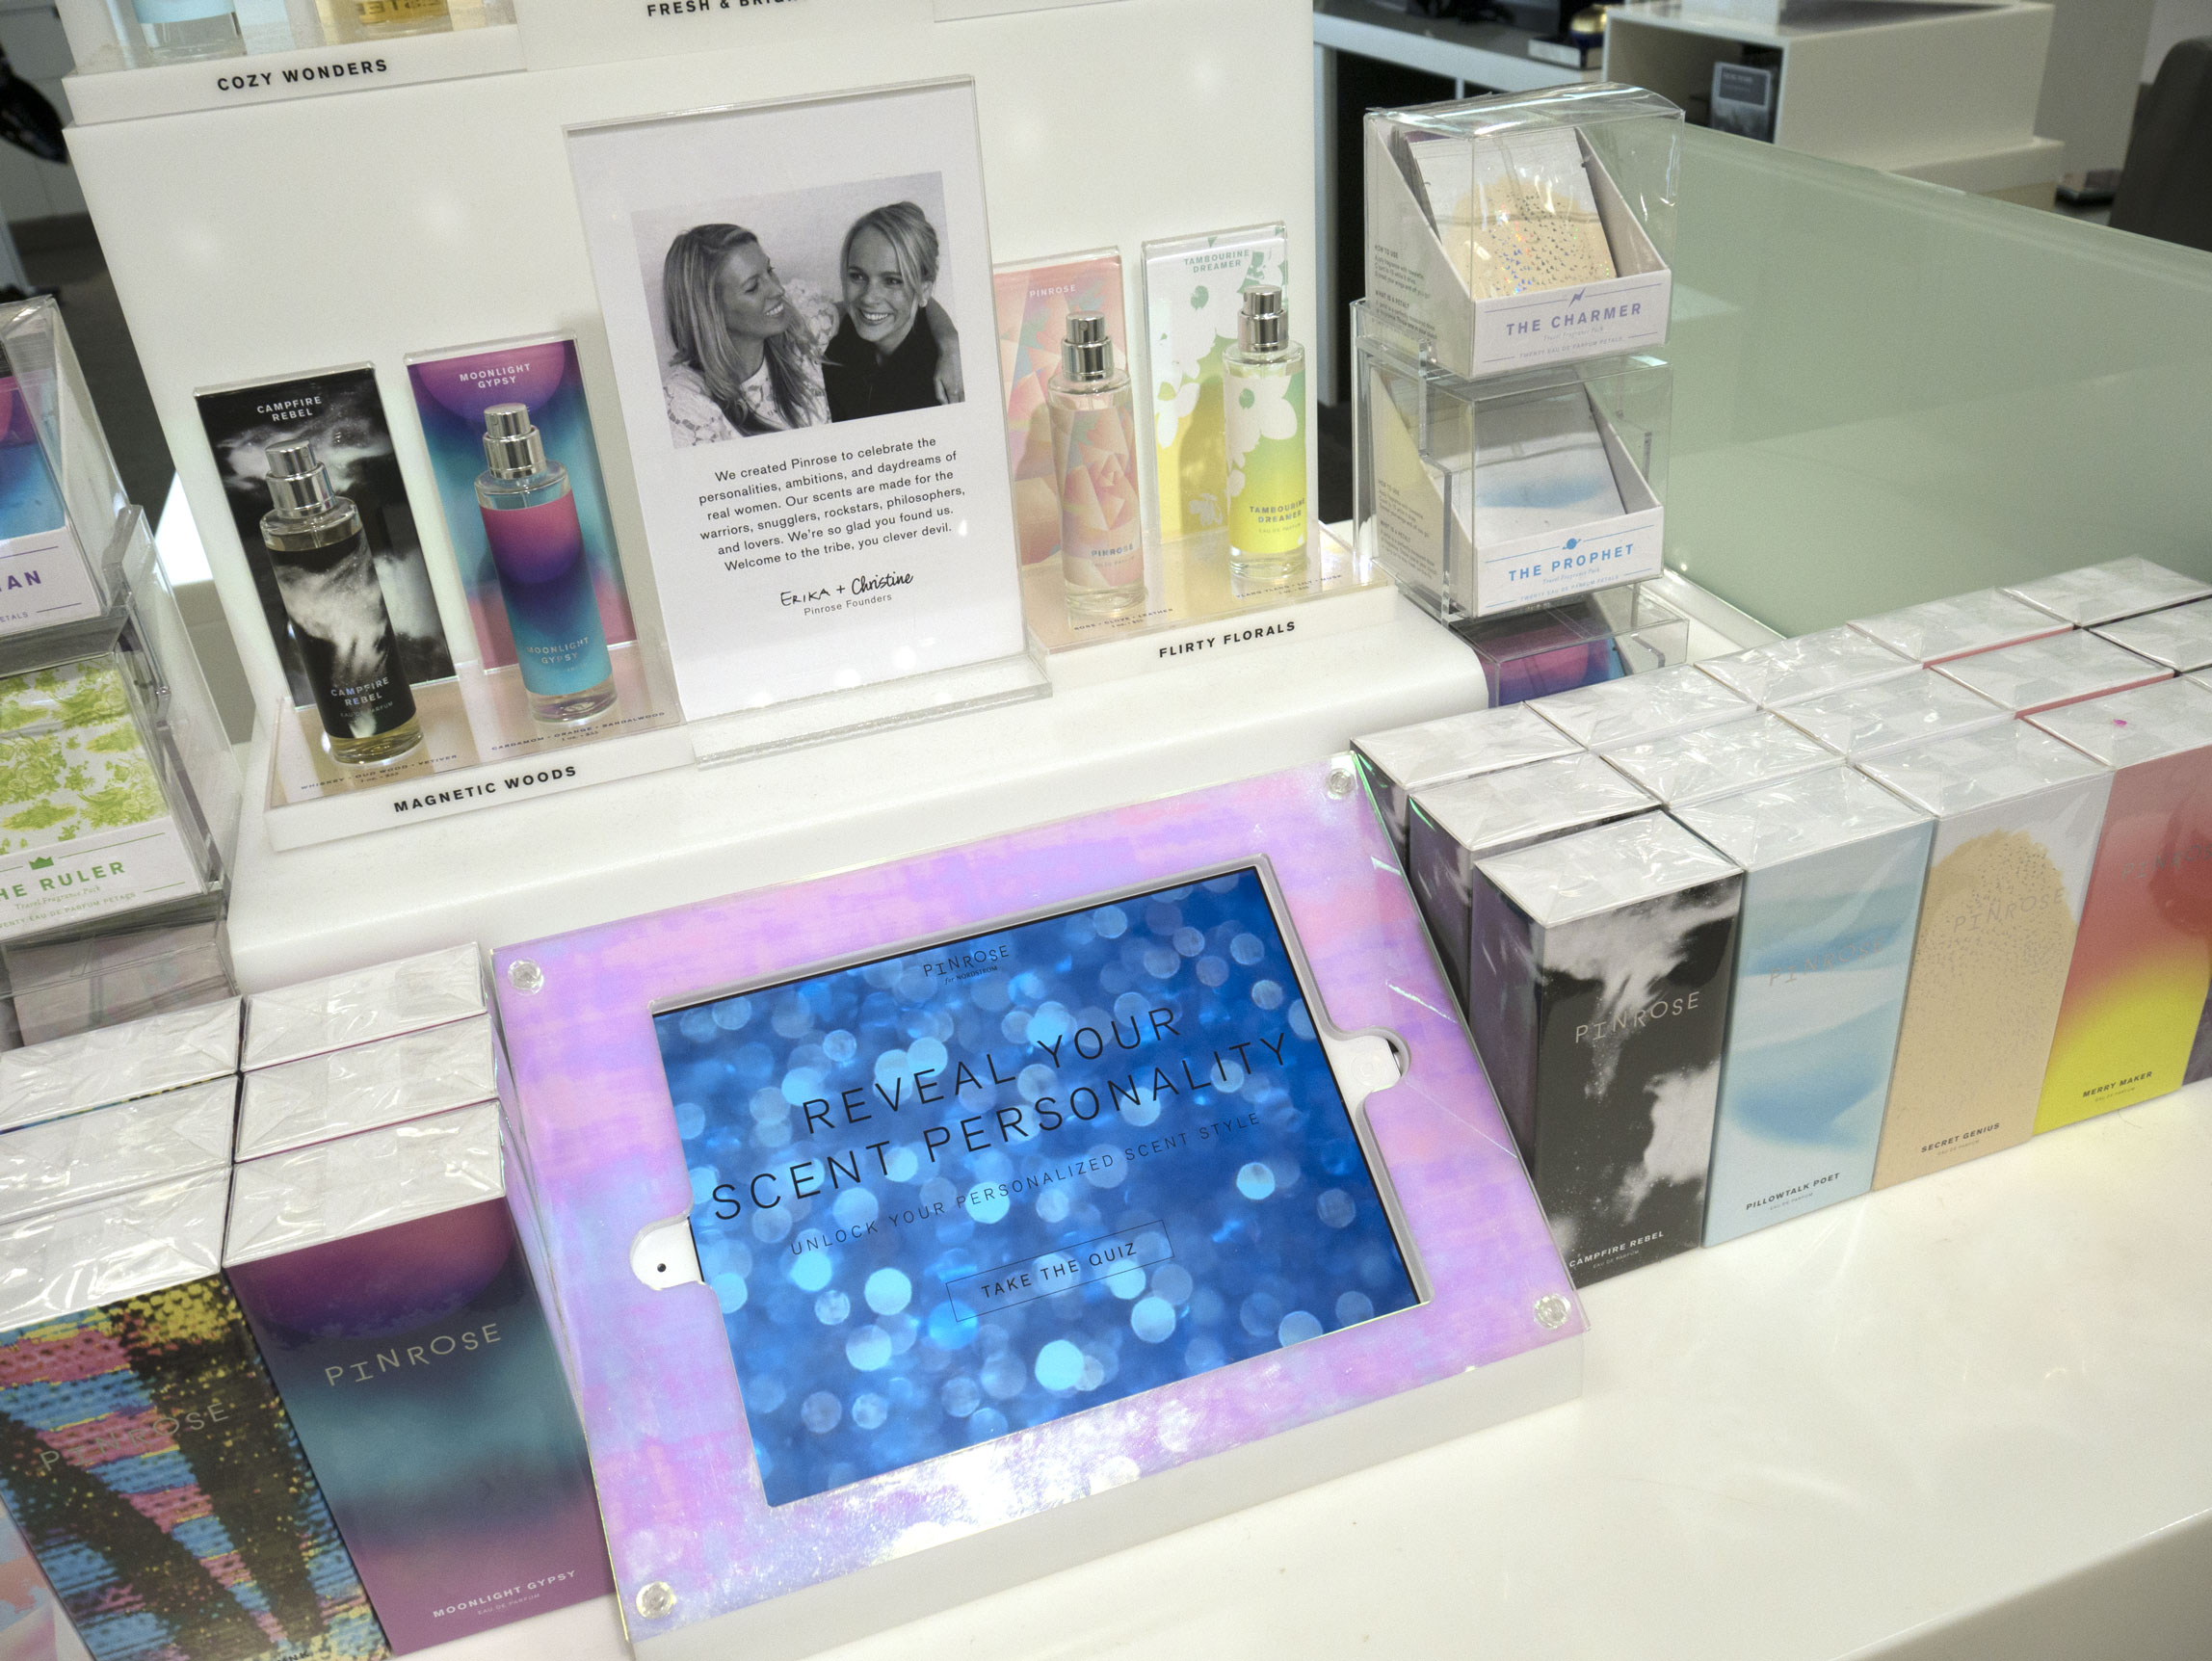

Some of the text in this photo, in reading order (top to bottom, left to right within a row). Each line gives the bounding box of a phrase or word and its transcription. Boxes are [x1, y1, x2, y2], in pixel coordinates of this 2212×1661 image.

[646, 0, 710, 16] FRESH
[217, 59, 388, 92] COZY WONDERS
[1183, 249, 1251, 267] TAMBOURINE
[1193, 259, 1243, 274] DREAMER
[1029, 283, 1077, 299] PINROSE
[1506, 303, 1642, 336] THE CHARMER
[459, 362, 532, 382] MOONLIGHT
[477, 375, 517, 389] GYPSY
[256, 395, 323, 414] CAMPFIRE
[272, 408, 314, 422] REBEL
[715, 437, 936, 482] We created Pinrose to celebrate the
[698, 450, 957, 506] personalities, ambitions, and daydreams of
[707, 470, 954, 520] real women. Our scents are made for the
[1250, 498, 1305, 514] TAMBOURINE
[699, 488, 965, 540] warriors, snugglers, rockstars, philosophers,
[718, 506, 954, 555] and lovers. We're so glad you found us.
[1257, 510, 1302, 523] DREAMER
[724, 522, 952, 571] Welcome to the tribe, you clever devil.
[1509, 543, 1634, 582] THE PROPHET
[0, 569, 41, 592] AN
[852, 570, 914, 594] Christine
[803, 593, 892, 616] Pinrose Founders
[526, 636, 591, 654] MOONLIGHT
[1159, 621, 1296, 658] FLIRTY FLORALS
[540, 651, 578, 665] GYPSY
[330, 676, 389, 697] CAMPFIRE
[344, 692, 382, 706] REBEL
[491, 737, 544, 751] CARDAMOM
[554, 725, 592, 738] ORANGE
[602, 711, 665, 728] SANDALWOOD
[380, 764, 408, 774] WOOD
[418, 754, 458, 766] VETIVER
[393, 766, 577, 812] MAGNETIC WOODS
[39, 861, 125, 891] RULER
[1953, 887, 2065, 933] PINROSE
[923, 944, 1009, 977] PINROSE
[956, 965, 998, 981] NORDSTROM
[1769, 936, 1884, 987] PINROSE
[1575, 990, 1700, 1043] PINROSE
[802, 1007, 1182, 1135] REVEAL YOUR
[2083, 1082, 2117, 1097] MERRY
[2120, 1070, 2152, 1087] MAKER
[711, 1032, 1286, 1221] SCENT PERSONALITY
[1921, 1135, 1960, 1153] SECRET
[1962, 1122, 2000, 1140] GENIUS
[791, 1112, 1260, 1256] UNLOCK YOUR PERSONALIZED SCENT STYLE
[1746, 1183, 1810, 1210] PILLOWTALK
[1813, 1173, 1840, 1187] POET
[1568, 1230, 1665, 1268] CAMPFIRE REBEL
[981, 1242, 1139, 1300] TAKE THE QUIZ
[325, 1323, 501, 1386] PINROSE
[40, 1402, 229, 1471] PINROSE
[433, 1569, 576, 1618] MOONLIGHT GYPSY
[477, 1593, 540, 1616] EAU DE PARFUM
